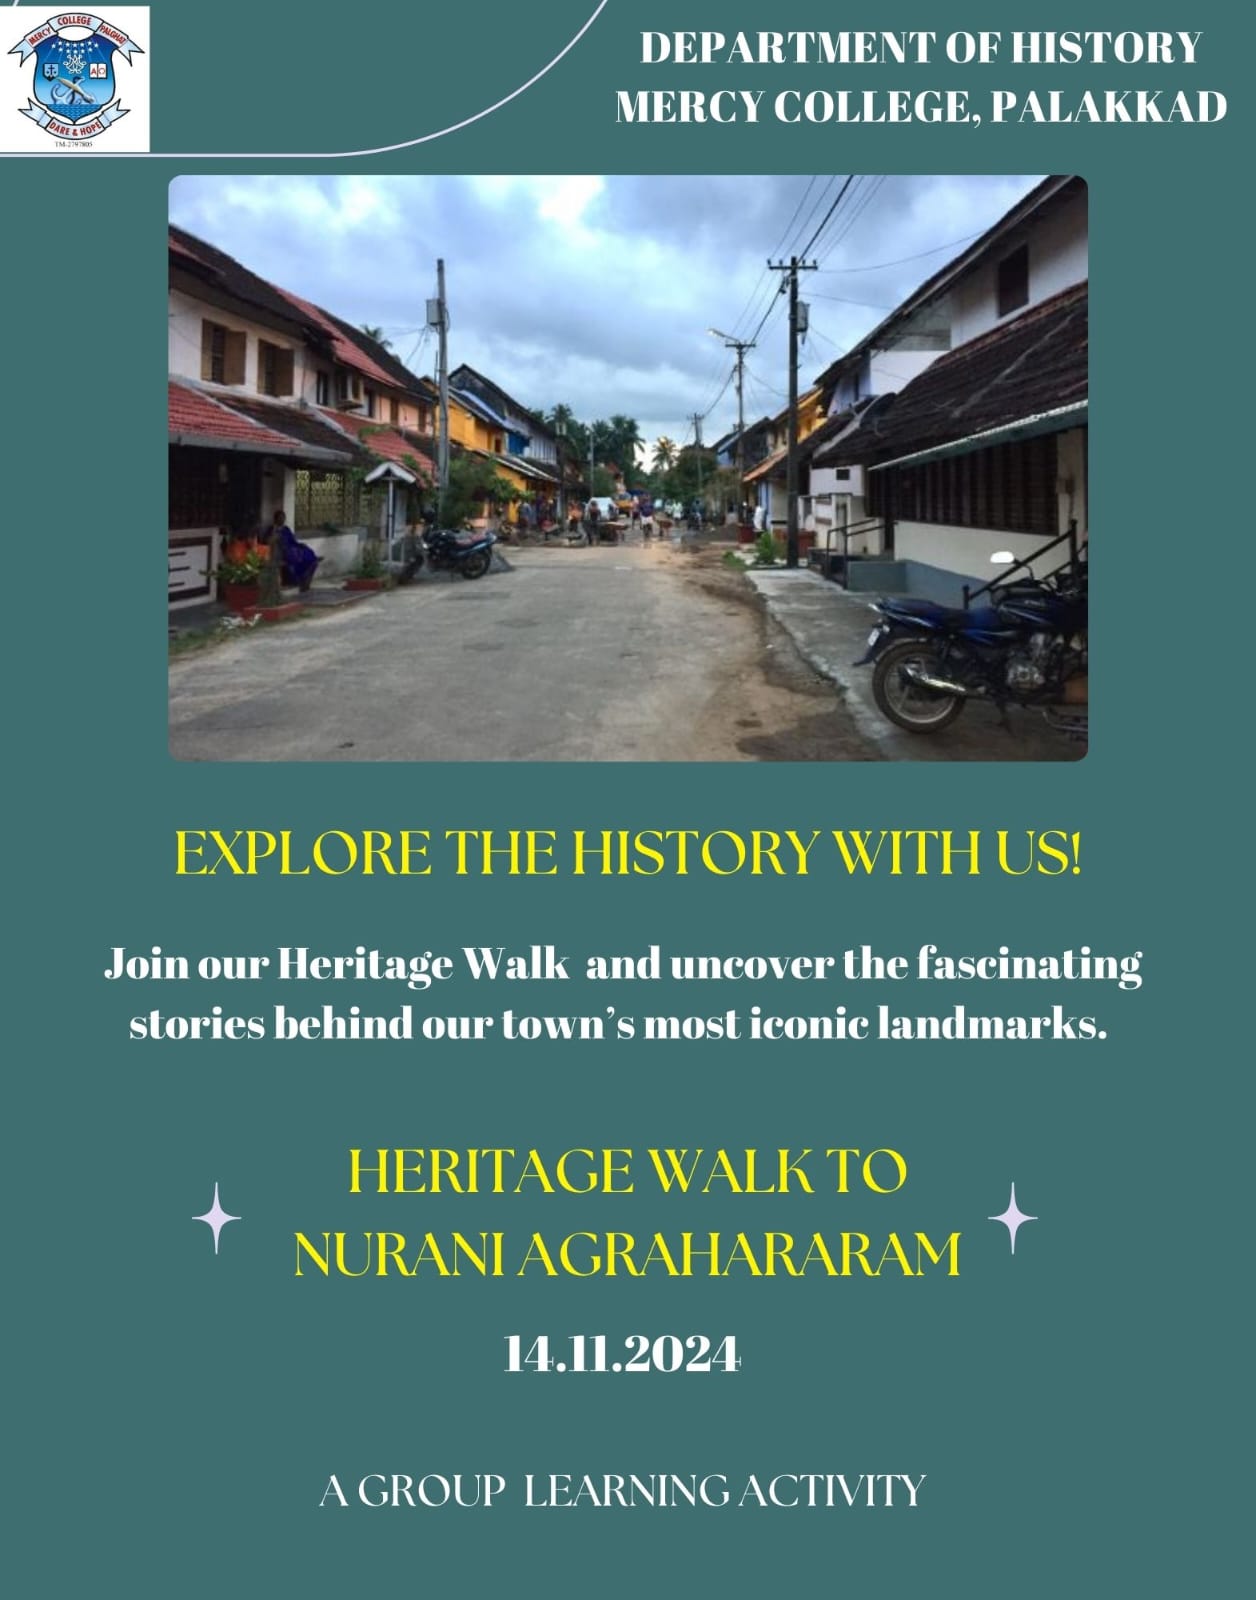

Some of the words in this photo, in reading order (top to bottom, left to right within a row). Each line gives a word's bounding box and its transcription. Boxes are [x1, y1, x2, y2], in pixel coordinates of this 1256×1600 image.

[28, 27, 51, 45] MERCY
[57, 16, 92, 26] COLLEGE
[99, 25, 127, 44] PALGHAT
[640, 31, 936, 64] DEPARTMENT
[946, 31, 1002, 64] OF
[1011, 31, 1204, 64] HISTORY
[49, 121, 70, 136] DARE
[72, 128, 78, 136] &
[80, 121, 102, 136] HOPE
[615, 90, 766, 123] MERCY
[775, 90, 981, 129] COLLEGE,
[991, 90, 1228, 123] PALAKKAD
[175, 829, 433, 876] EXPLORE
[444, 829, 559, 876] THE
[573, 829, 821, 876] HISTORY
[831, 829, 981, 876] WITH
[996, 829, 1082, 876] US!
[103, 945, 190, 980] Join
[198, 954, 270, 980] our
[277, 945, 454, 991] Heritage
[461, 944, 571, 980] Walk
[586, 944, 662, 980] and
[670, 956, 836, 980] uncover
[843, 944, 909, 980] the
[917, 944, 1144, 990] fascinating
[129, 1005, 266, 1040] stories
[274, 1004, 413, 1040] behind
[422, 1015, 494, 1040] our
[502, 1006, 636, 1040] town’s
[643, 1009, 742, 1040] most
[750, 1005, 869, 1040] iconic
[877, 1004, 1108, 1040] landmarks.
[349, 1147, 635, 1194] HERITAGE
[647, 1147, 816, 1194] WALK
[826, 1147, 908, 1195] TO
[294, 1231, 505, 1278] NURANI
[516, 1231, 962, 1278] AGRAHARARAM
[503, 1334, 742, 1373] 14.11.2024
[319, 1474, 349, 1507] A
[358, 1474, 506, 1507] GROUP
[524, 1474, 730, 1507] LEARNING
[738, 1474, 927, 1507] ACTIVITY
